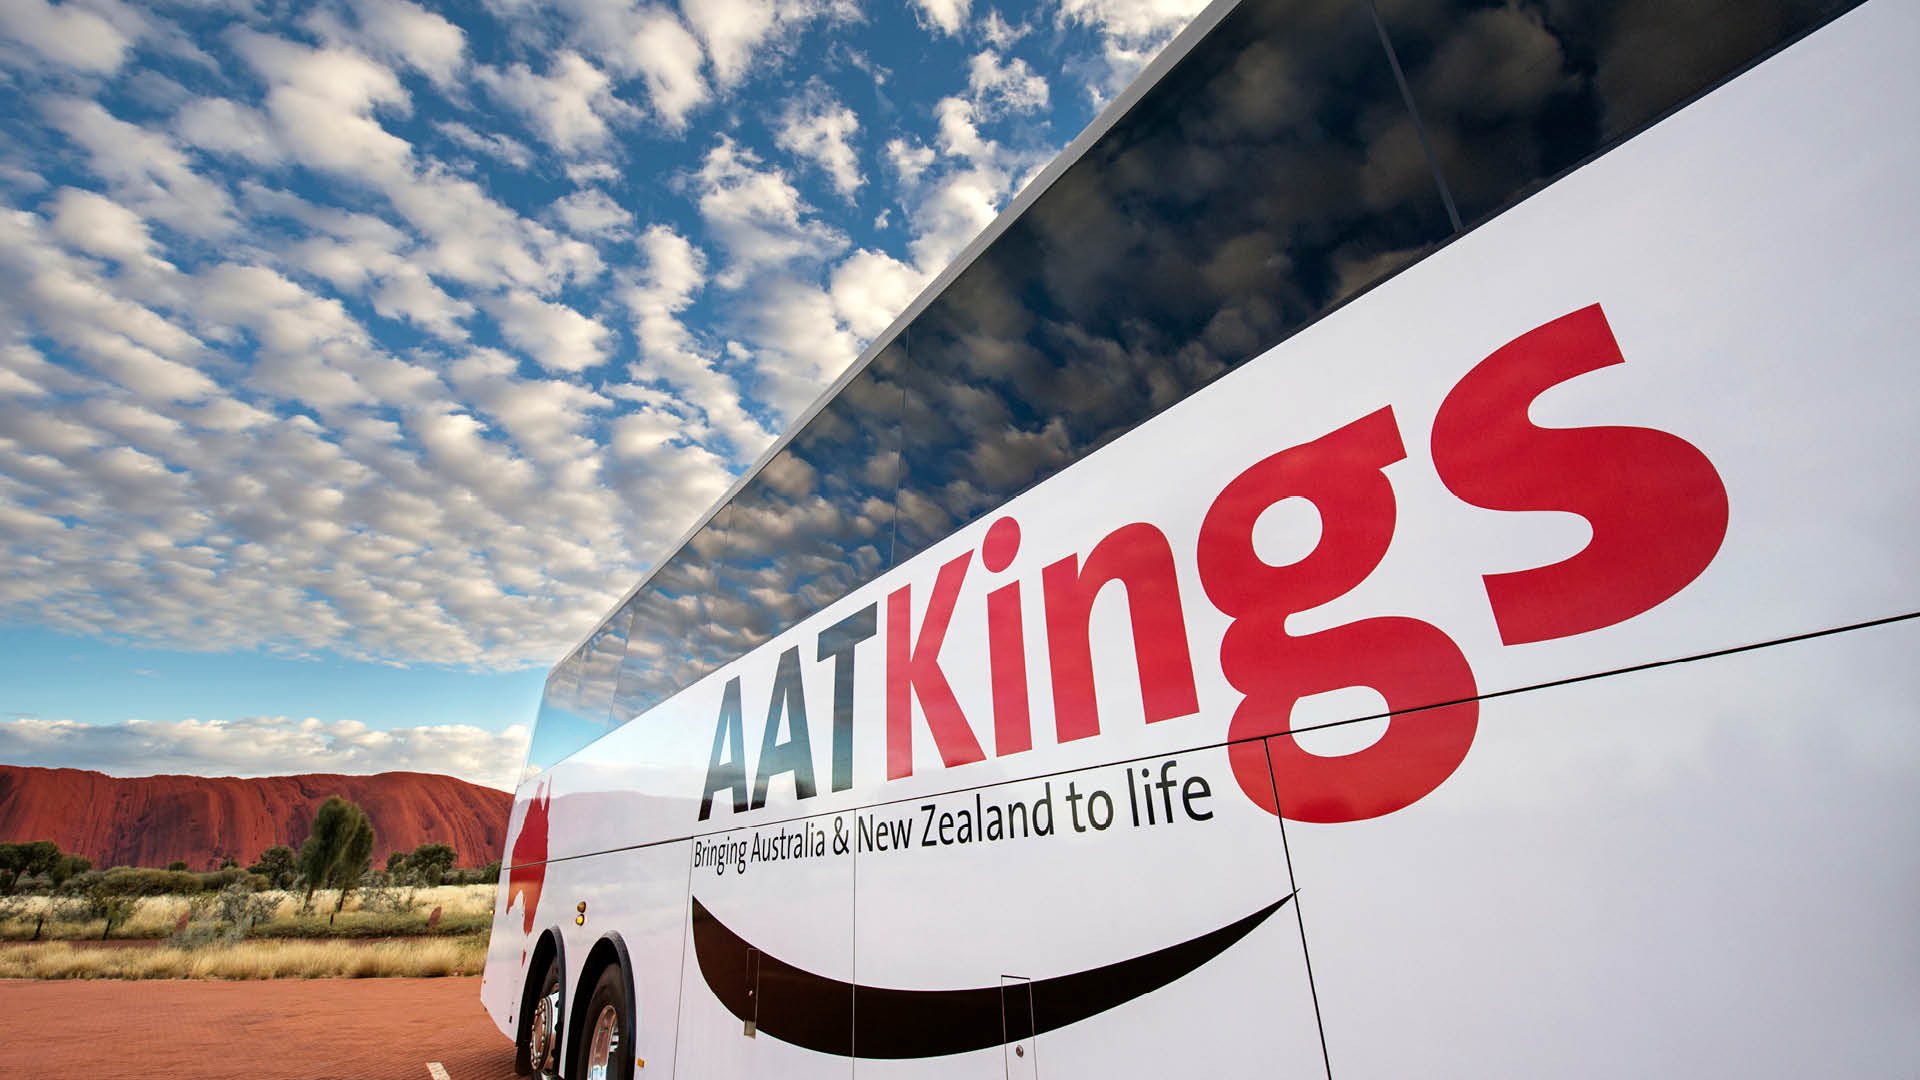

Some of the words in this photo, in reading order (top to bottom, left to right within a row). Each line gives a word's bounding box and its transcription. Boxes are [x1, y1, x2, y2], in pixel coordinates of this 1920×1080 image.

[694, 837, 746, 875] Bringing
[750, 822, 825, 864] Australia
[832, 816, 850, 854] &
[857, 813, 912, 853] New
[920, 782, 1053, 847] Zealand
[1066, 781, 1114, 832] to
[1126, 760, 1213, 827] life
